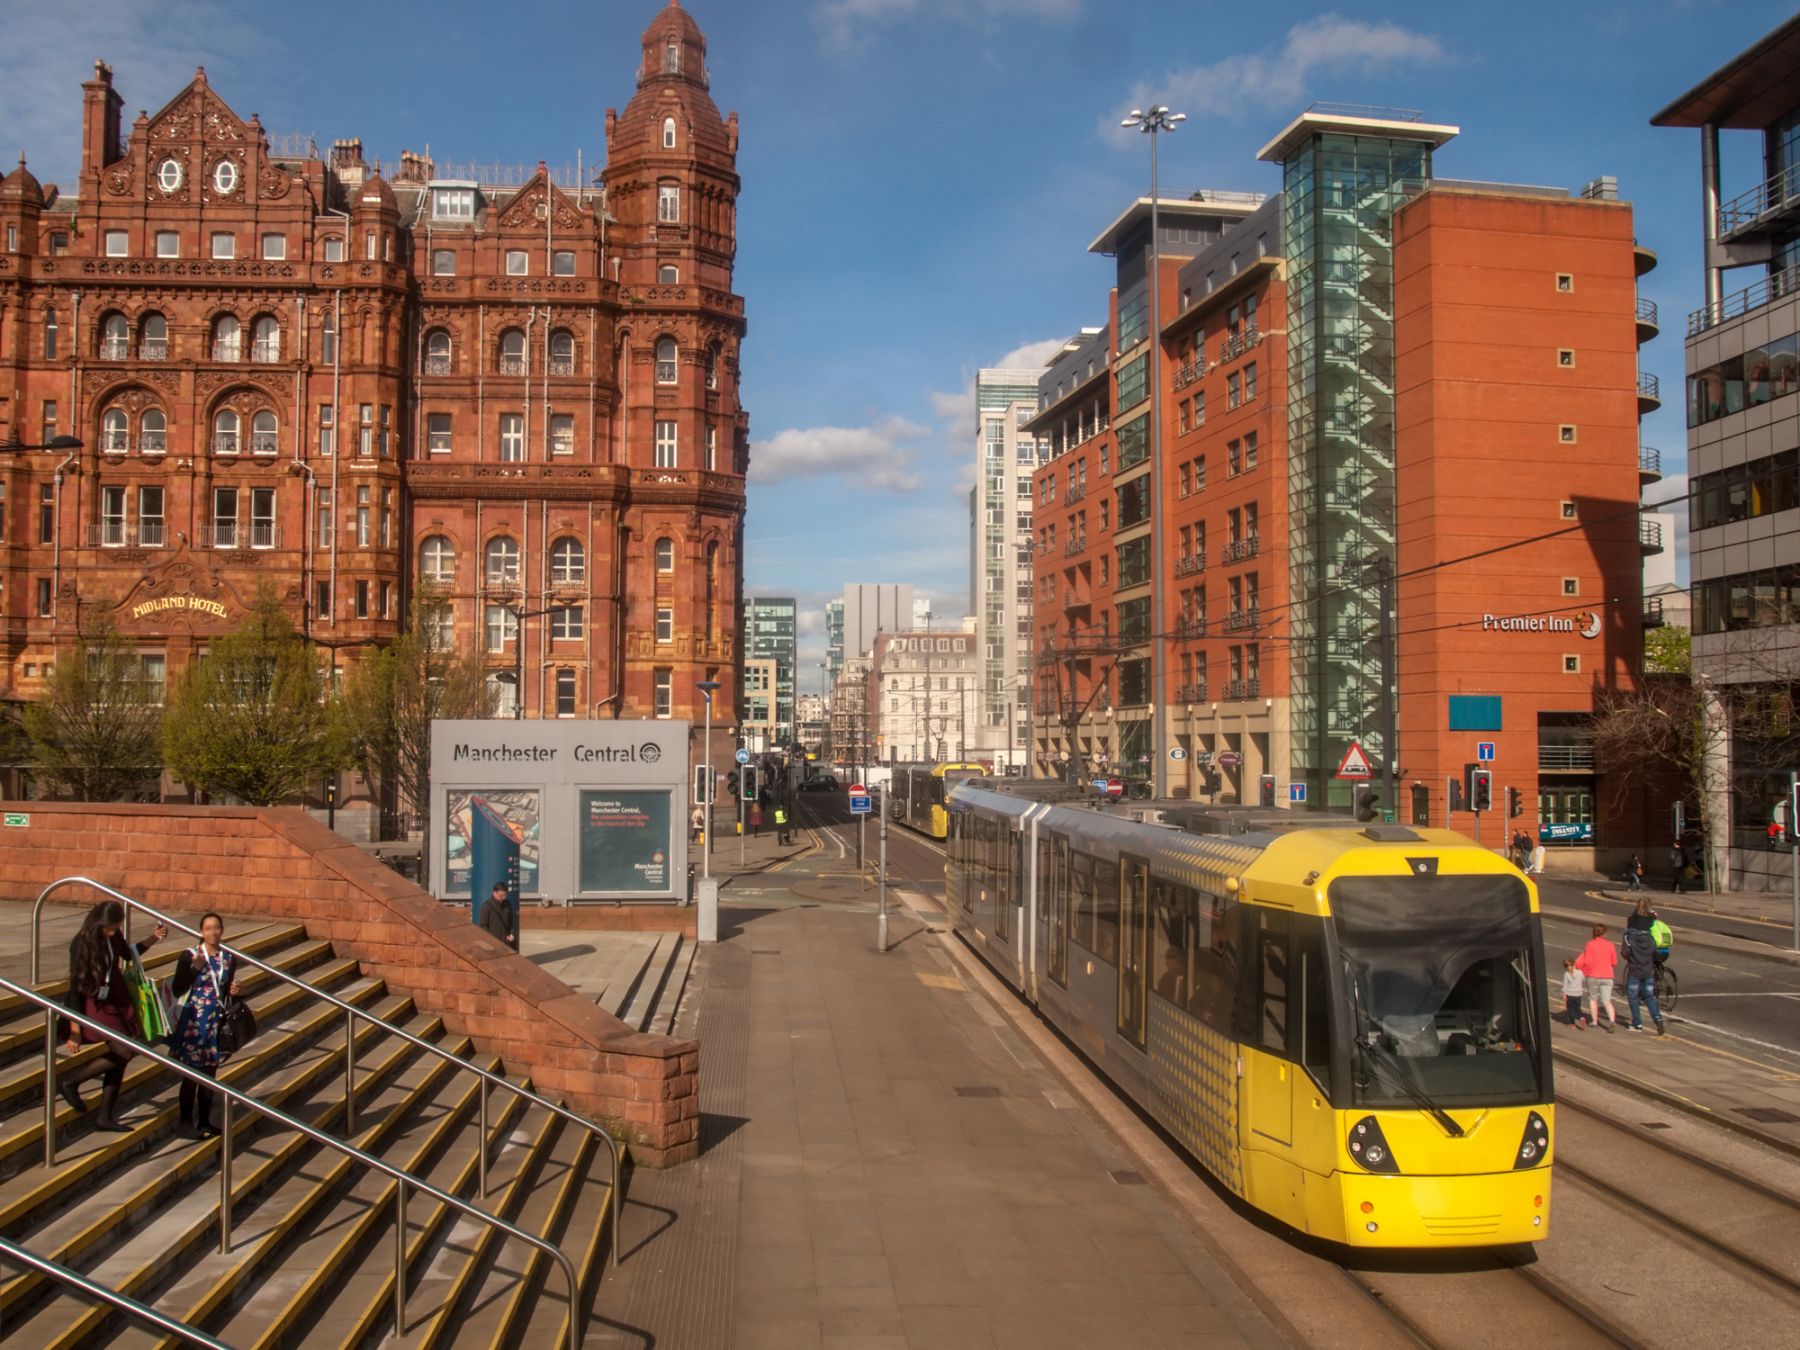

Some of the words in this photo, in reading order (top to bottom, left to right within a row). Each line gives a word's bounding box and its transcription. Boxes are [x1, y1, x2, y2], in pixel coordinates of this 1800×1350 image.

[133, 597, 185, 618] MIDLAND
[189, 598, 227, 618] HOTEL
[1483, 614, 1546, 631] Premier
[1550, 615, 1573, 631] Inn
[453, 744, 557, 762] Manchester
[574, 744, 636, 762] Central
